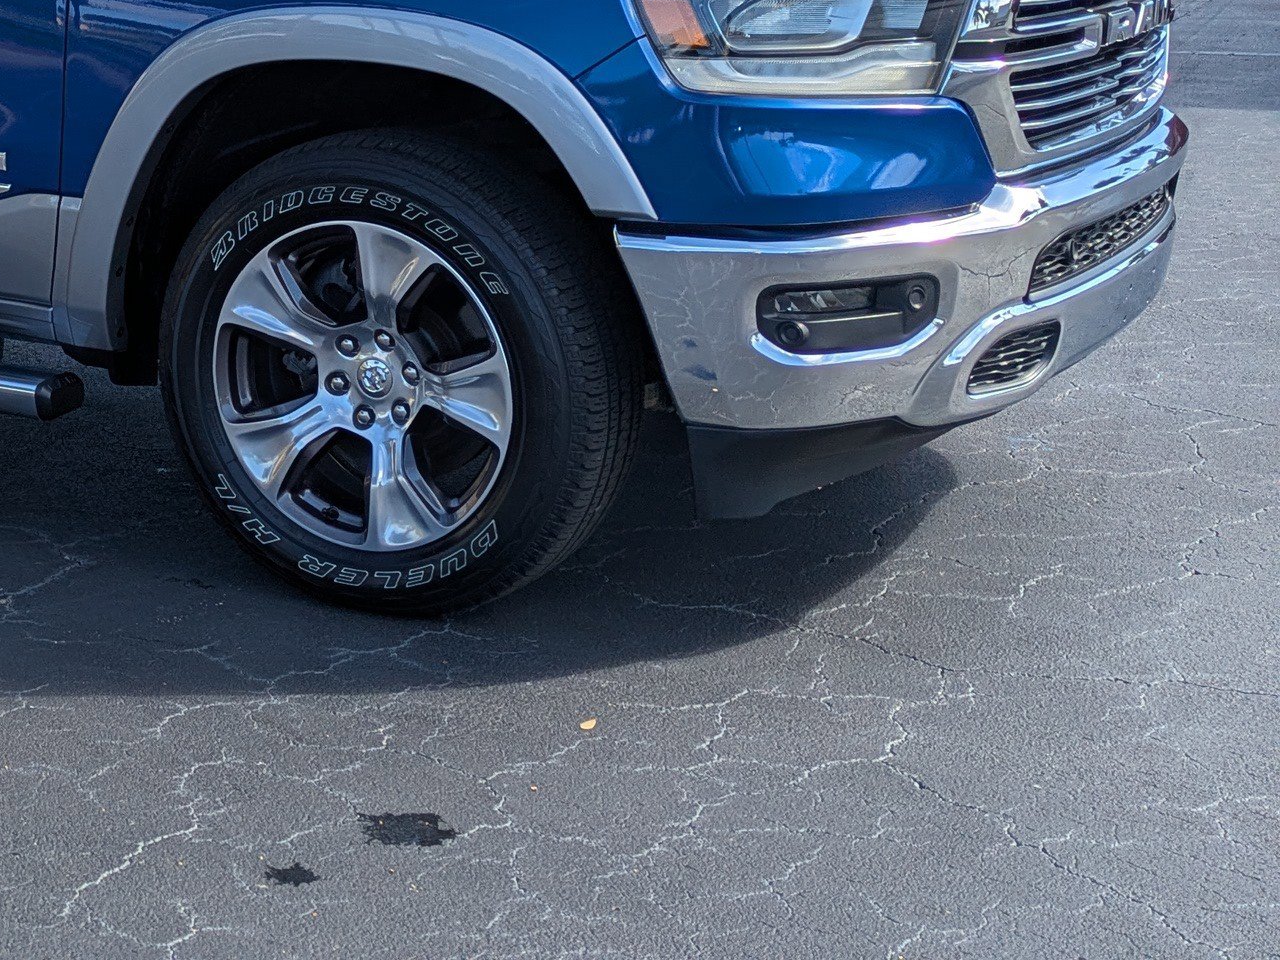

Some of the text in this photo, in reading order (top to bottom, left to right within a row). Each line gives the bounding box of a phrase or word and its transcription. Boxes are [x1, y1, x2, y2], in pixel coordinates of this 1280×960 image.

[210, 185, 510, 296] BRIDGESTONE
[214, 473, 499, 590] DUELER H/L
